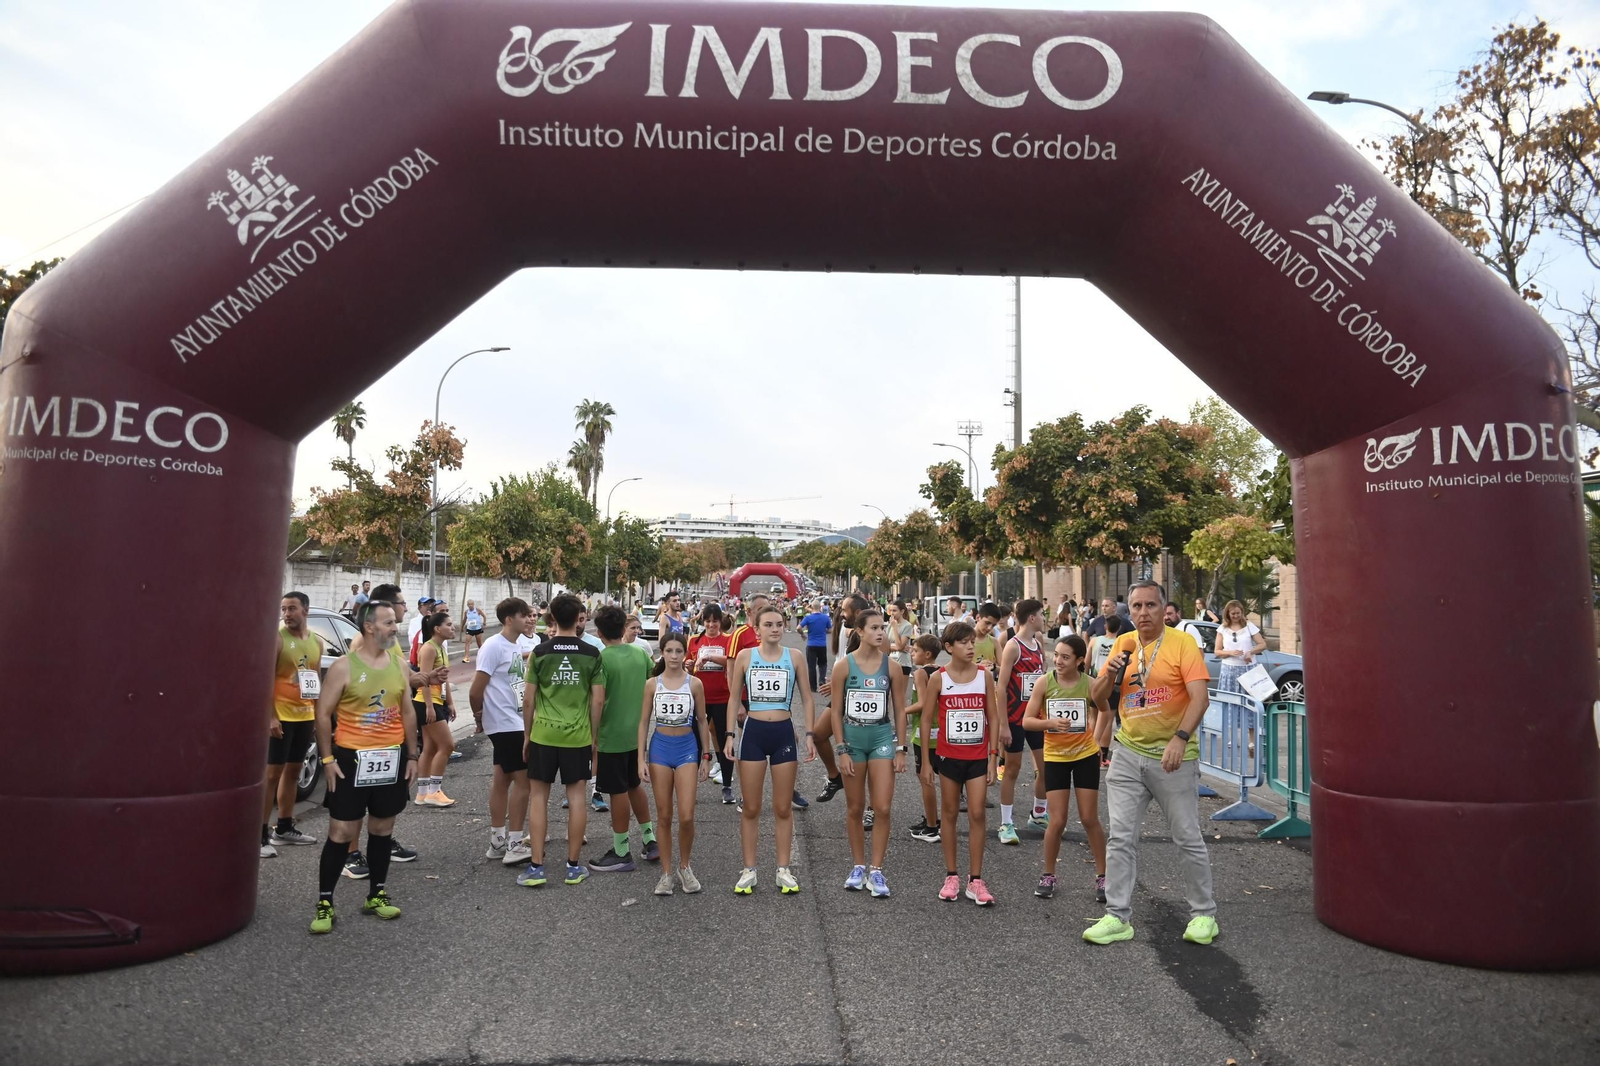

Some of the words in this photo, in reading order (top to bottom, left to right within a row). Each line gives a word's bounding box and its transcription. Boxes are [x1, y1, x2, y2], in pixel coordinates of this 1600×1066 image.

[644, 23, 1123, 111] IMDECO
[499, 119, 624, 148] Instituto
[634, 122, 784, 158] Municipal
[794, 127, 833, 153] de
[843, 128, 982, 162] Deportes
[991, 132, 1117, 161] Córdoba
[170, 240, 318, 363] AYUNTAMIENTO
[310, 217, 348, 251] DE
[339, 147, 439, 228] CÓRDOBA
[1181, 167, 1318, 288] AYUNTAMIENTO
[1310, 279, 1346, 313] DE
[1337, 303, 1428, 388] CÓRDOBA
[8, 395, 229, 453] IMDECO
[1430, 422, 1577, 466] IMDEC
[60, 448, 79, 461] de
[83, 449, 157, 467] Deportes
[161, 457, 223, 476] Córdoba
[1365, 478, 1424, 493] Instituto
[1428, 471, 1501, 488] Municipal
[1505, 471, 1522, 483] de
[1525, 470, 1570, 486] Deportes
[551, 671, 580, 681] AIRE
[757, 679, 780, 691] 316
[661, 703, 684, 715] 313
[854, 701, 878, 713] 309
[945, 696, 984, 709] CURTIUS
[955, 721, 978, 733] 319
[366, 760, 391, 773] 315
